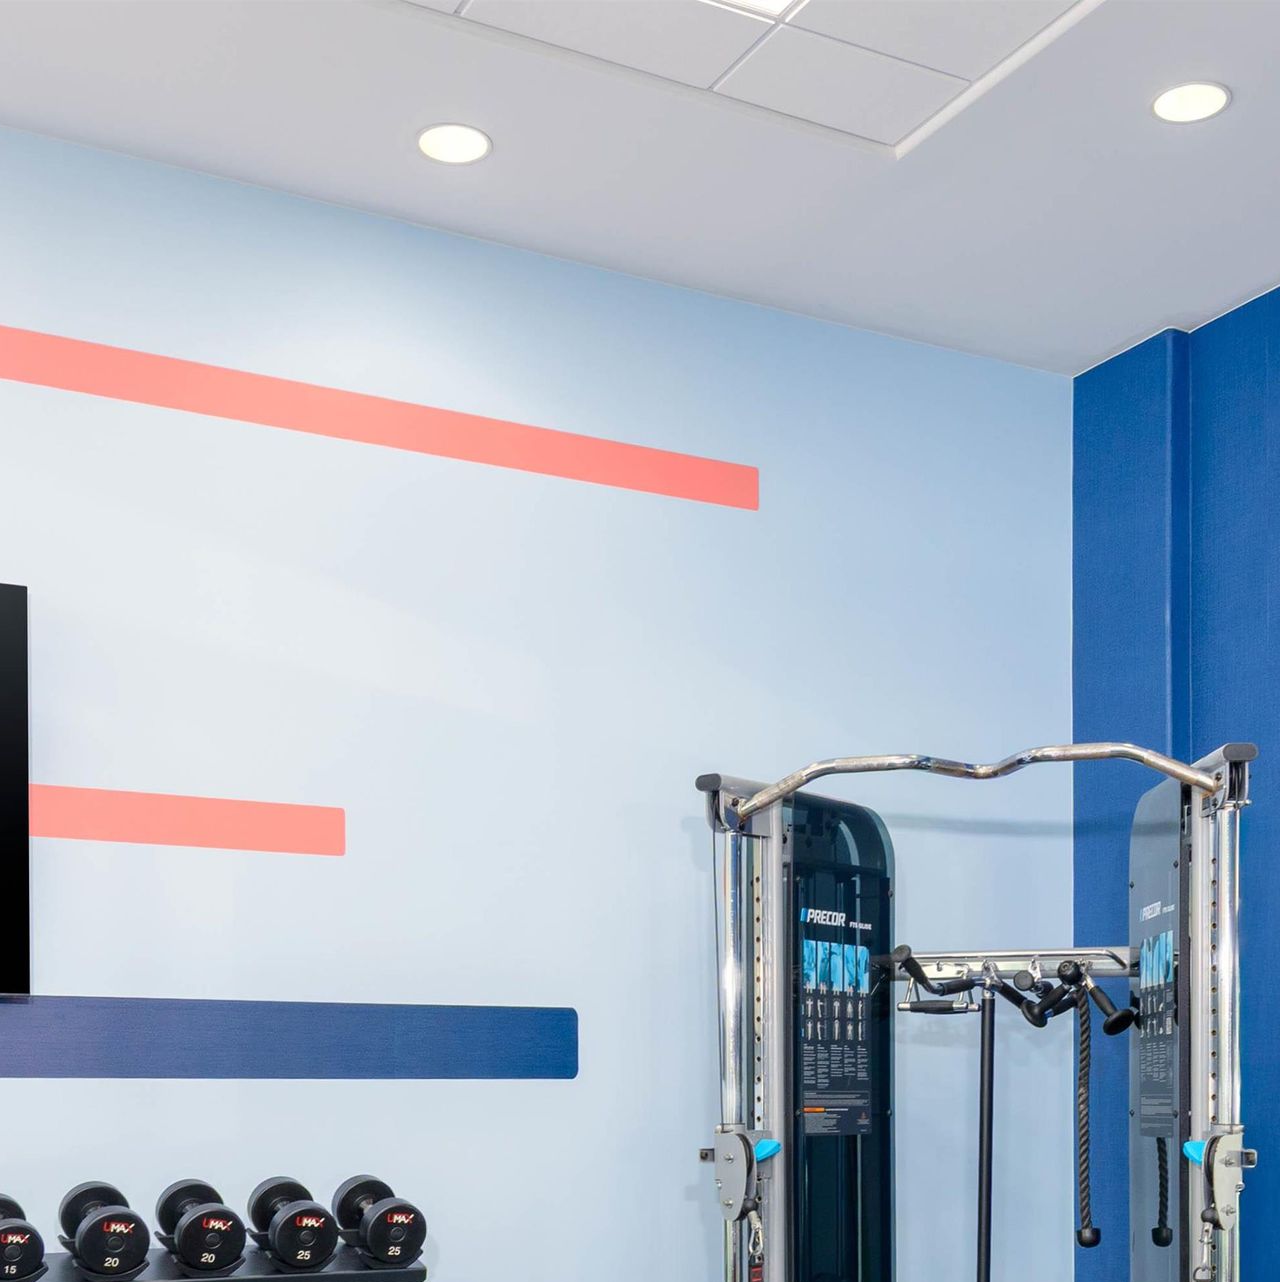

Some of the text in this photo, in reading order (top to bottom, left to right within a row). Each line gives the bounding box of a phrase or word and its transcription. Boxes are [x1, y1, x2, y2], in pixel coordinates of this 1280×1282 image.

[807, 908, 846, 927] PRECOR
[295, 1215, 325, 1228] UMAX
[386, 1212, 415, 1224] UMAX
[102, 1221, 136, 1234] UMAX
[202, 1217, 233, 1231] UMAX
[0, 1233, 31, 1244] UMAX
[296, 1250, 311, 1260] 25
[387, 1245, 401, 1256] 25
[103, 1257, 120, 1268] 20
[200, 1252, 216, 1263] 20
[4, 1263, 17, 1274] 15
